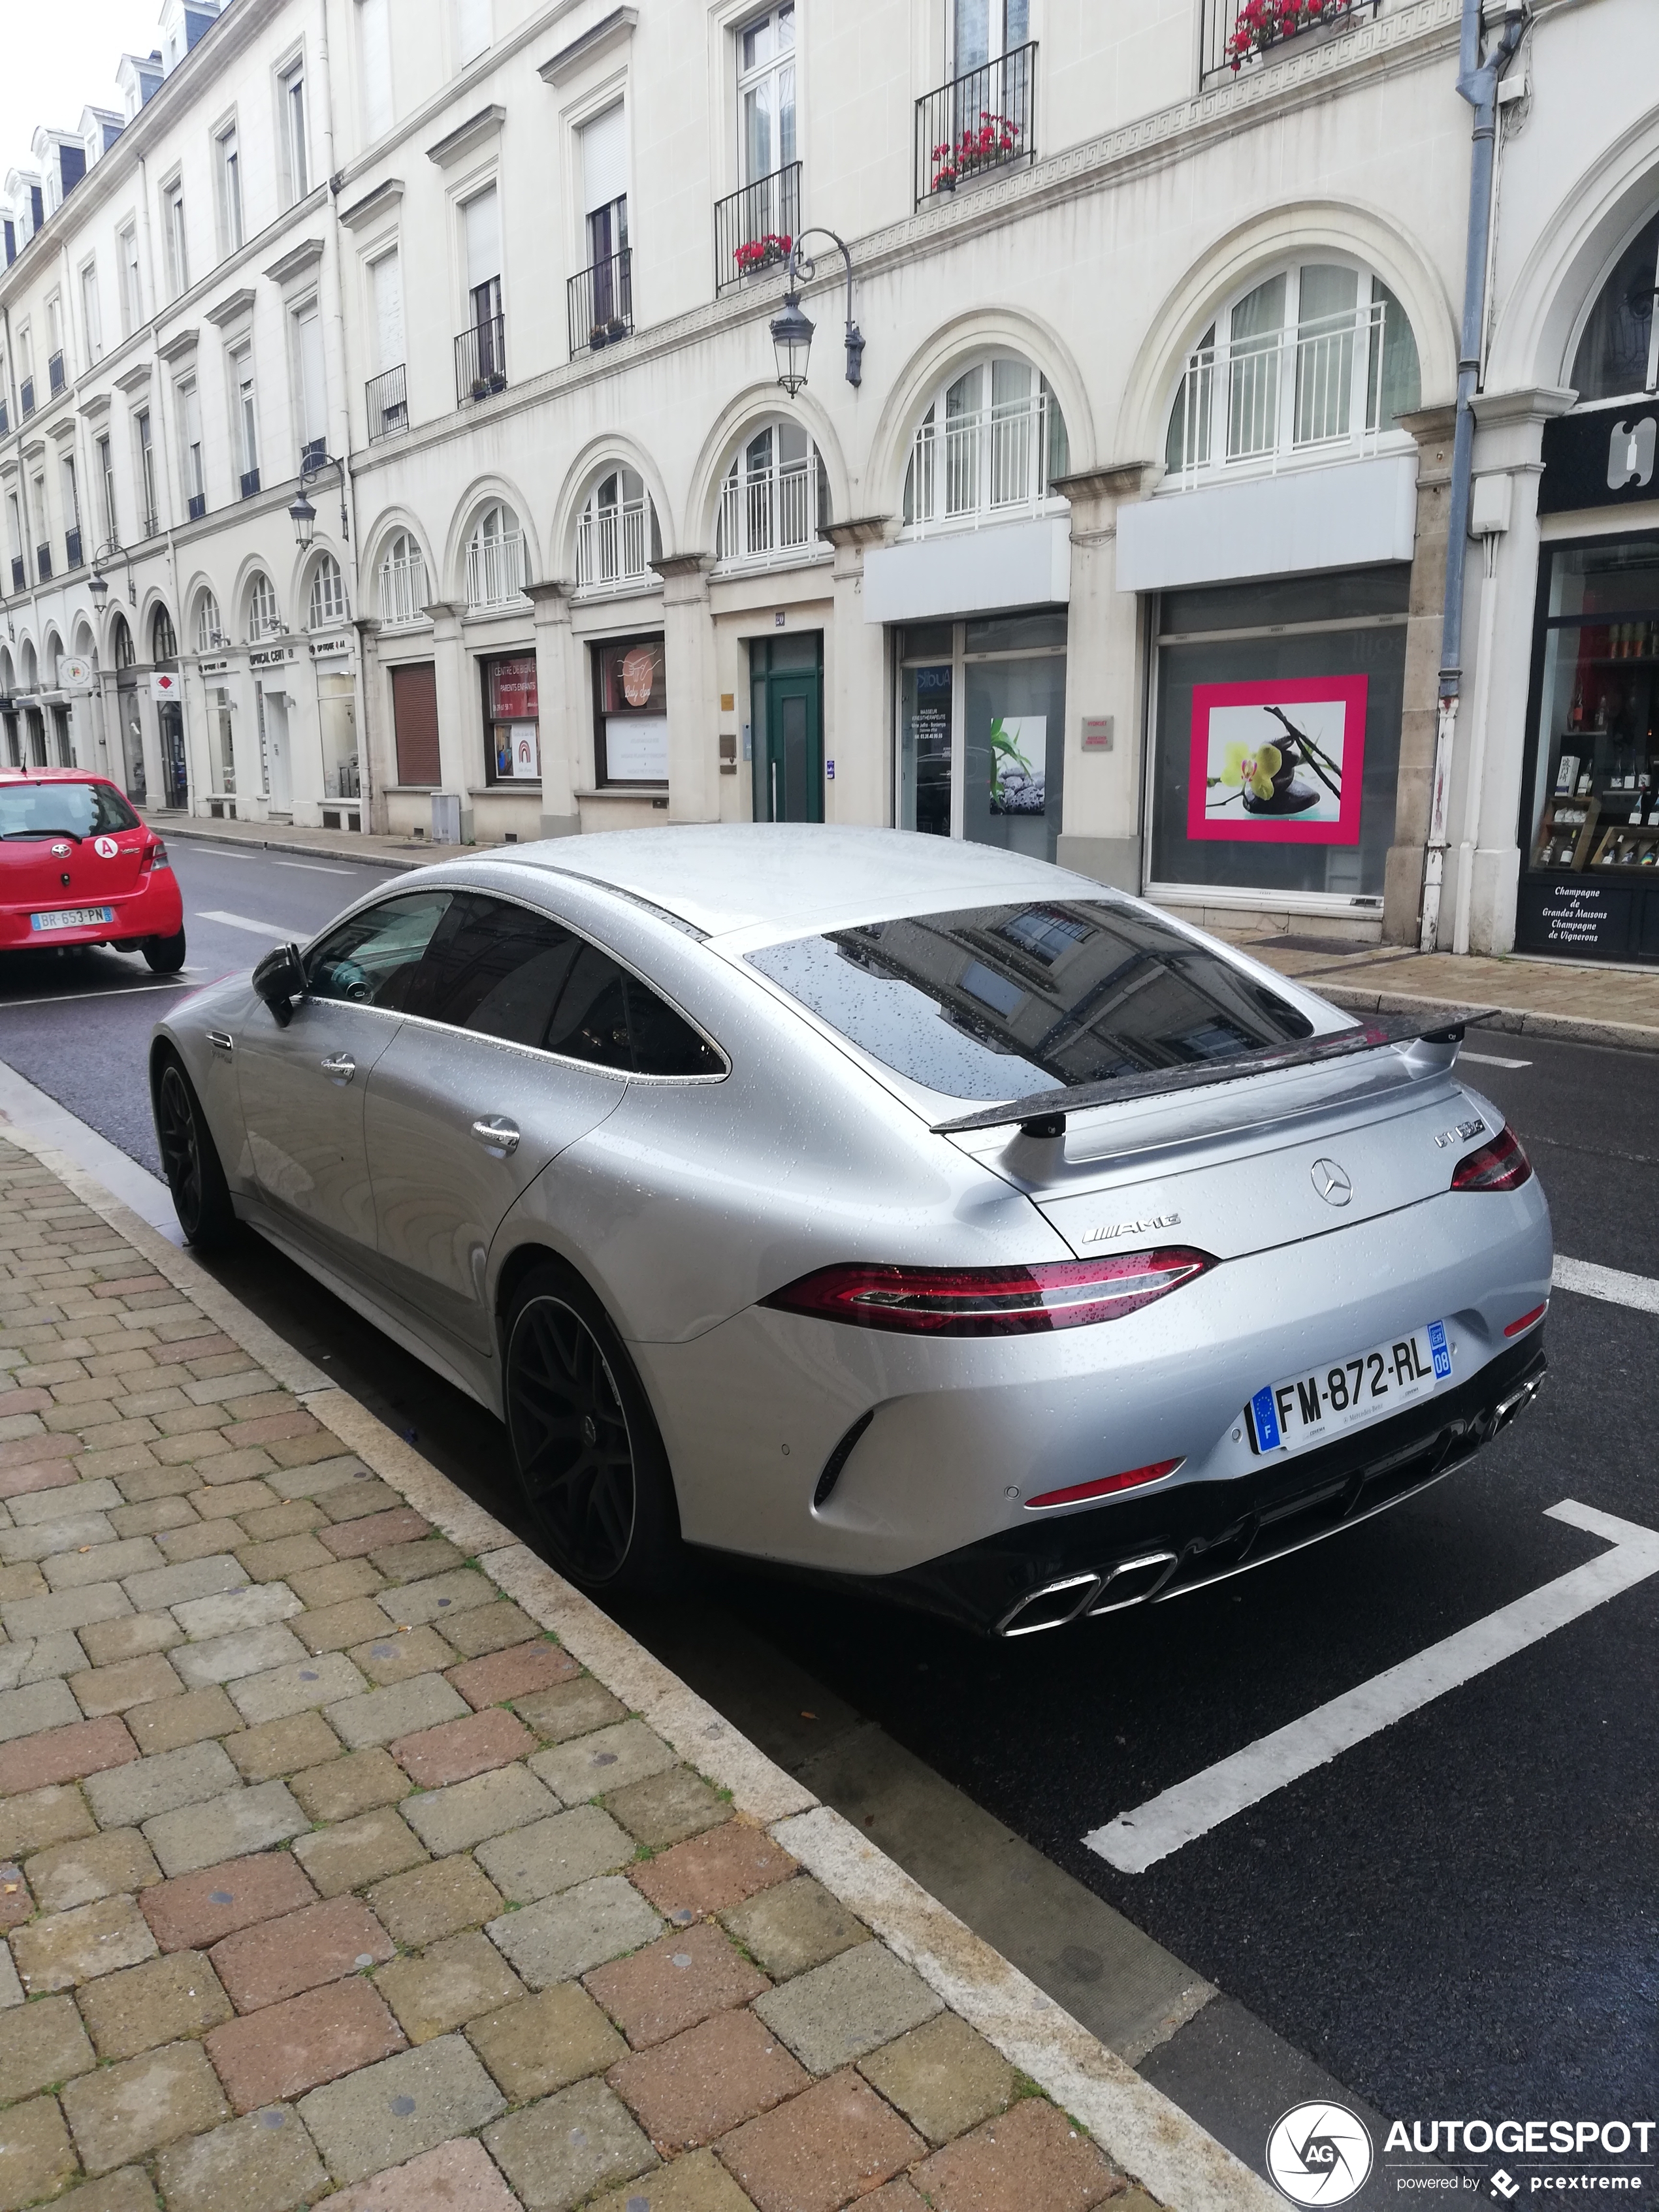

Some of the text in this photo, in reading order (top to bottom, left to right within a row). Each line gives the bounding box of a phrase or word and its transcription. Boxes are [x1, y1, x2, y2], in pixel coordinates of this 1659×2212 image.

[776, 615, 784, 624] 20
[250, 652, 270, 665] OPTICAL
[494, 665, 513, 677] CENTRE
[513, 665, 520, 675] DE
[500, 681, 536, 692] PARENTS ENFANTS
[624, 684, 639, 702] Baby
[102, 840, 114, 855] A
[1554, 886, 1600, 899] Champagne
[1570, 899, 1581, 908] de
[40, 908, 104, 927] BR-653-PN
[1542, 907, 1607, 919] Grandes Maisons
[1551, 919, 1597, 932] Champagne
[1548, 930, 1598, 942] de Vignerons
[1434, 1131, 1455, 1147] GT
[1434, 1351, 1449, 1374] 08
[1276, 1338, 1432, 1434] FM-872-RL
[1349, 1403, 1384, 1422] Mercedes-Benz
[1264, 1424, 1271, 1439] F
